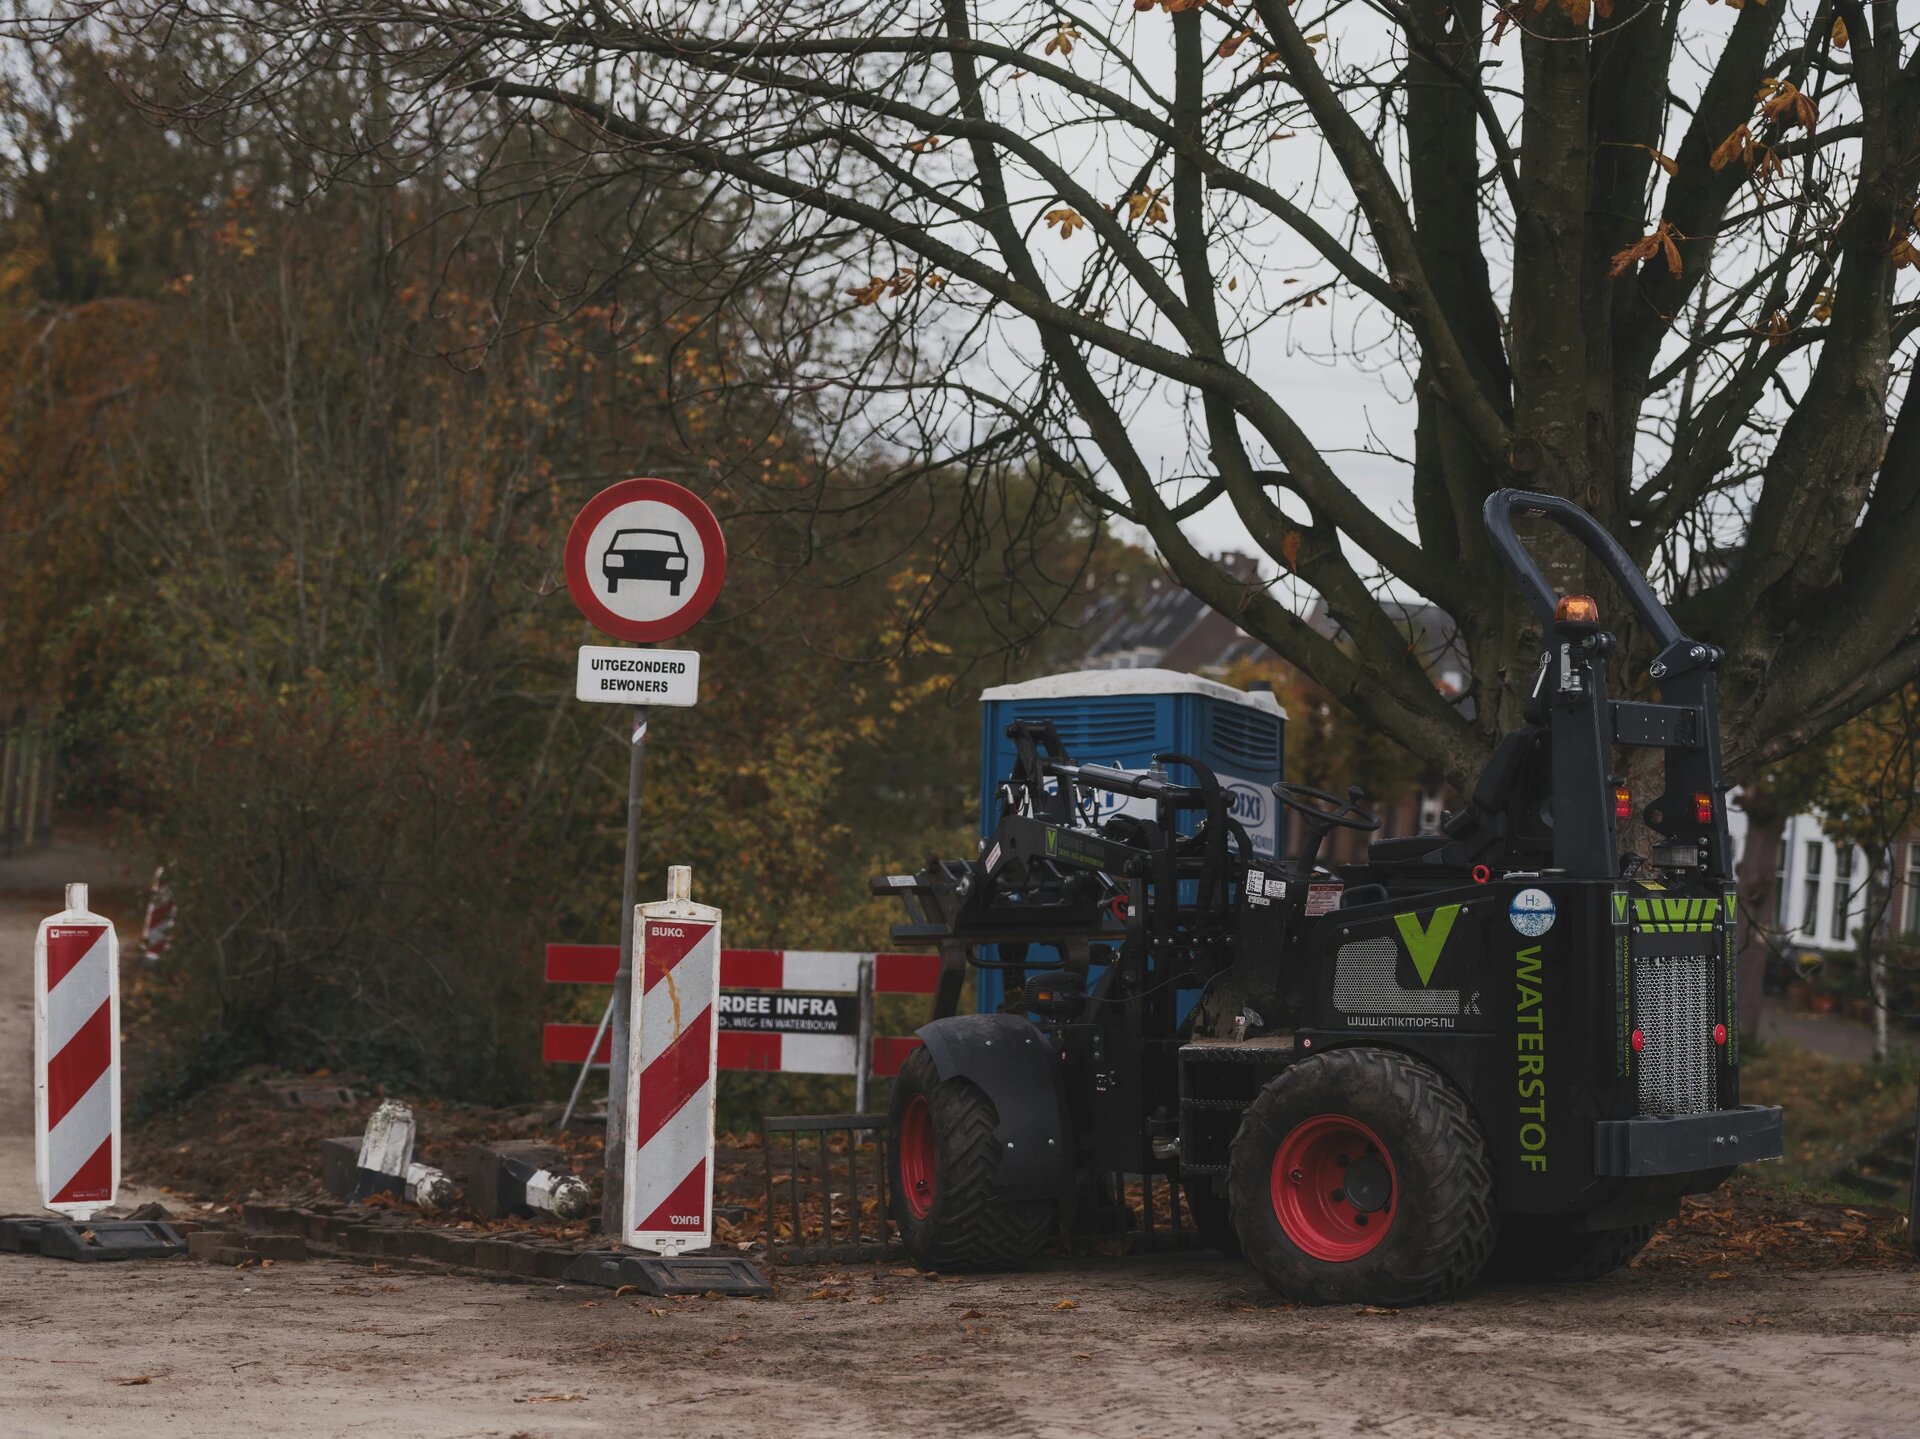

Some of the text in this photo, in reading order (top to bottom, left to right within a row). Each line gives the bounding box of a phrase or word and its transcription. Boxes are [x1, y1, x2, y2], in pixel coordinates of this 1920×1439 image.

[591, 658, 686, 674] UITGEZONDERD
[600, 678, 668, 693] BEWONERS
[1525, 894, 1541, 907] H2
[651, 926, 685, 938] BUKO.
[1393, 903, 1462, 988] V
[776, 997, 838, 1016] INFRA
[760, 1018, 774, 1028] EN
[775, 1018, 838, 1030] WATERBOUW
[1515, 944, 1547, 1172] WATERSTOF
